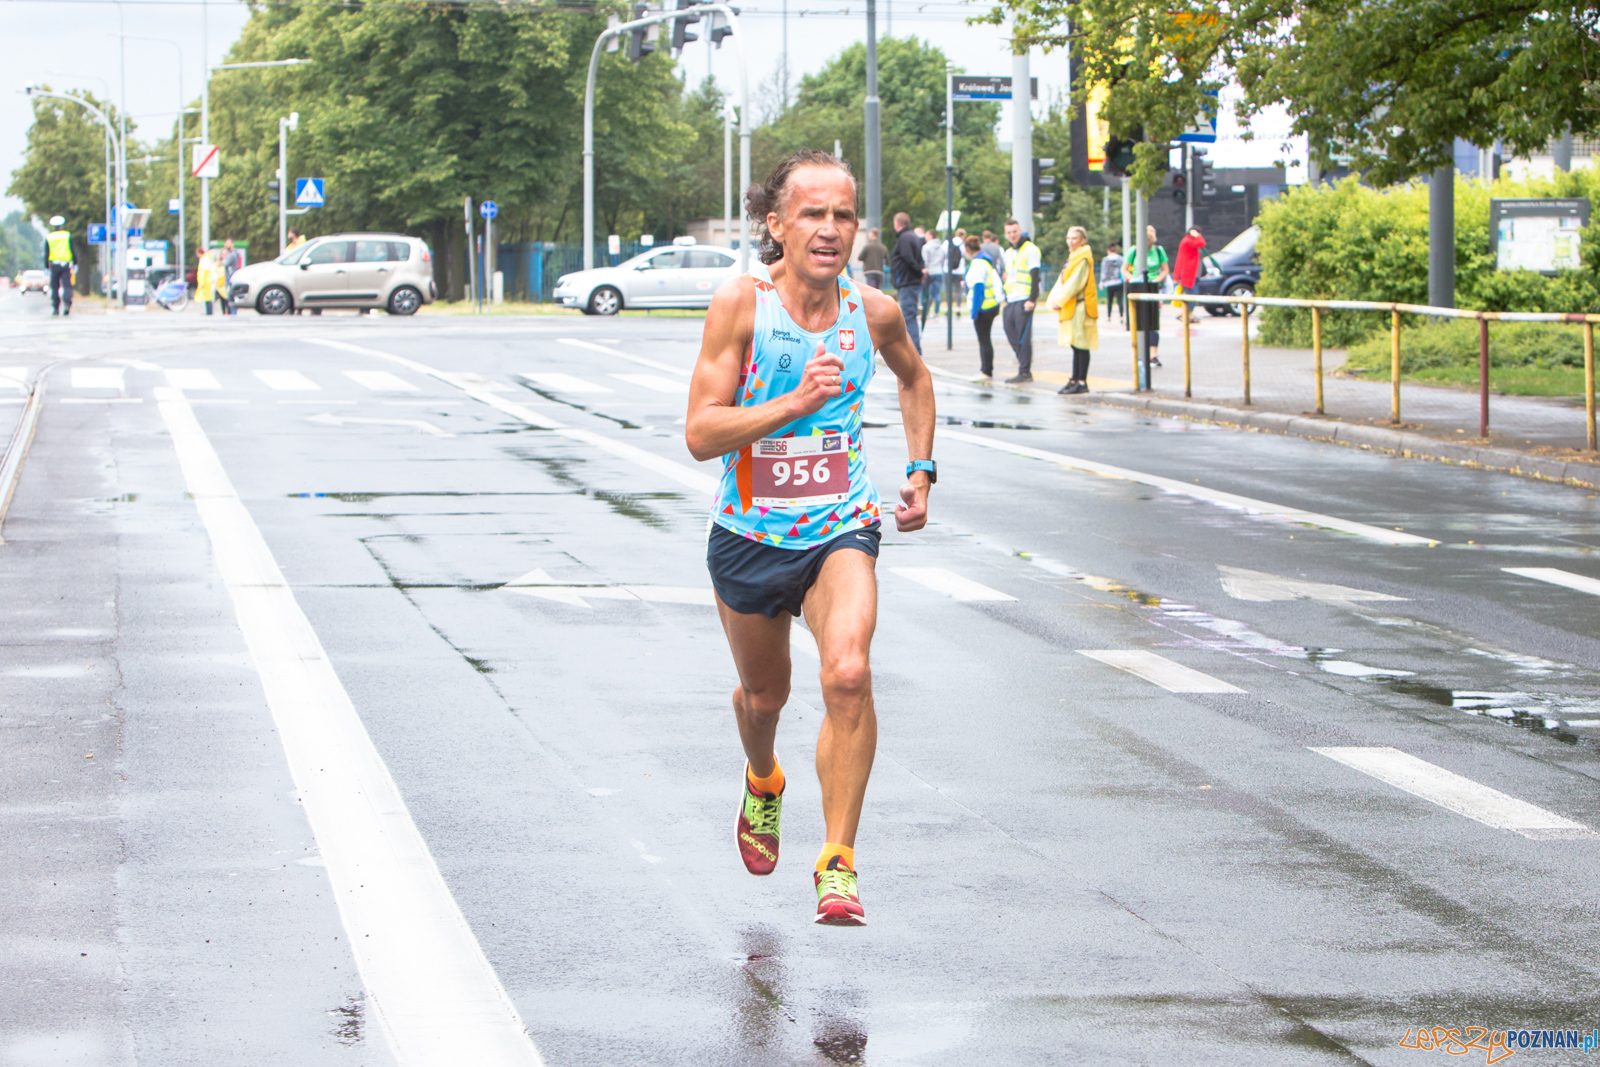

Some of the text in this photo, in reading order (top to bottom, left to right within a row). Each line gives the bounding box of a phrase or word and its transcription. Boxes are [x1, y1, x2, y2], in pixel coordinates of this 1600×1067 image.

[959, 83, 995, 93] Królowej
[775, 441, 788, 452] 56
[772, 457, 831, 486] 956
[740, 832, 776, 861] BROOKS
